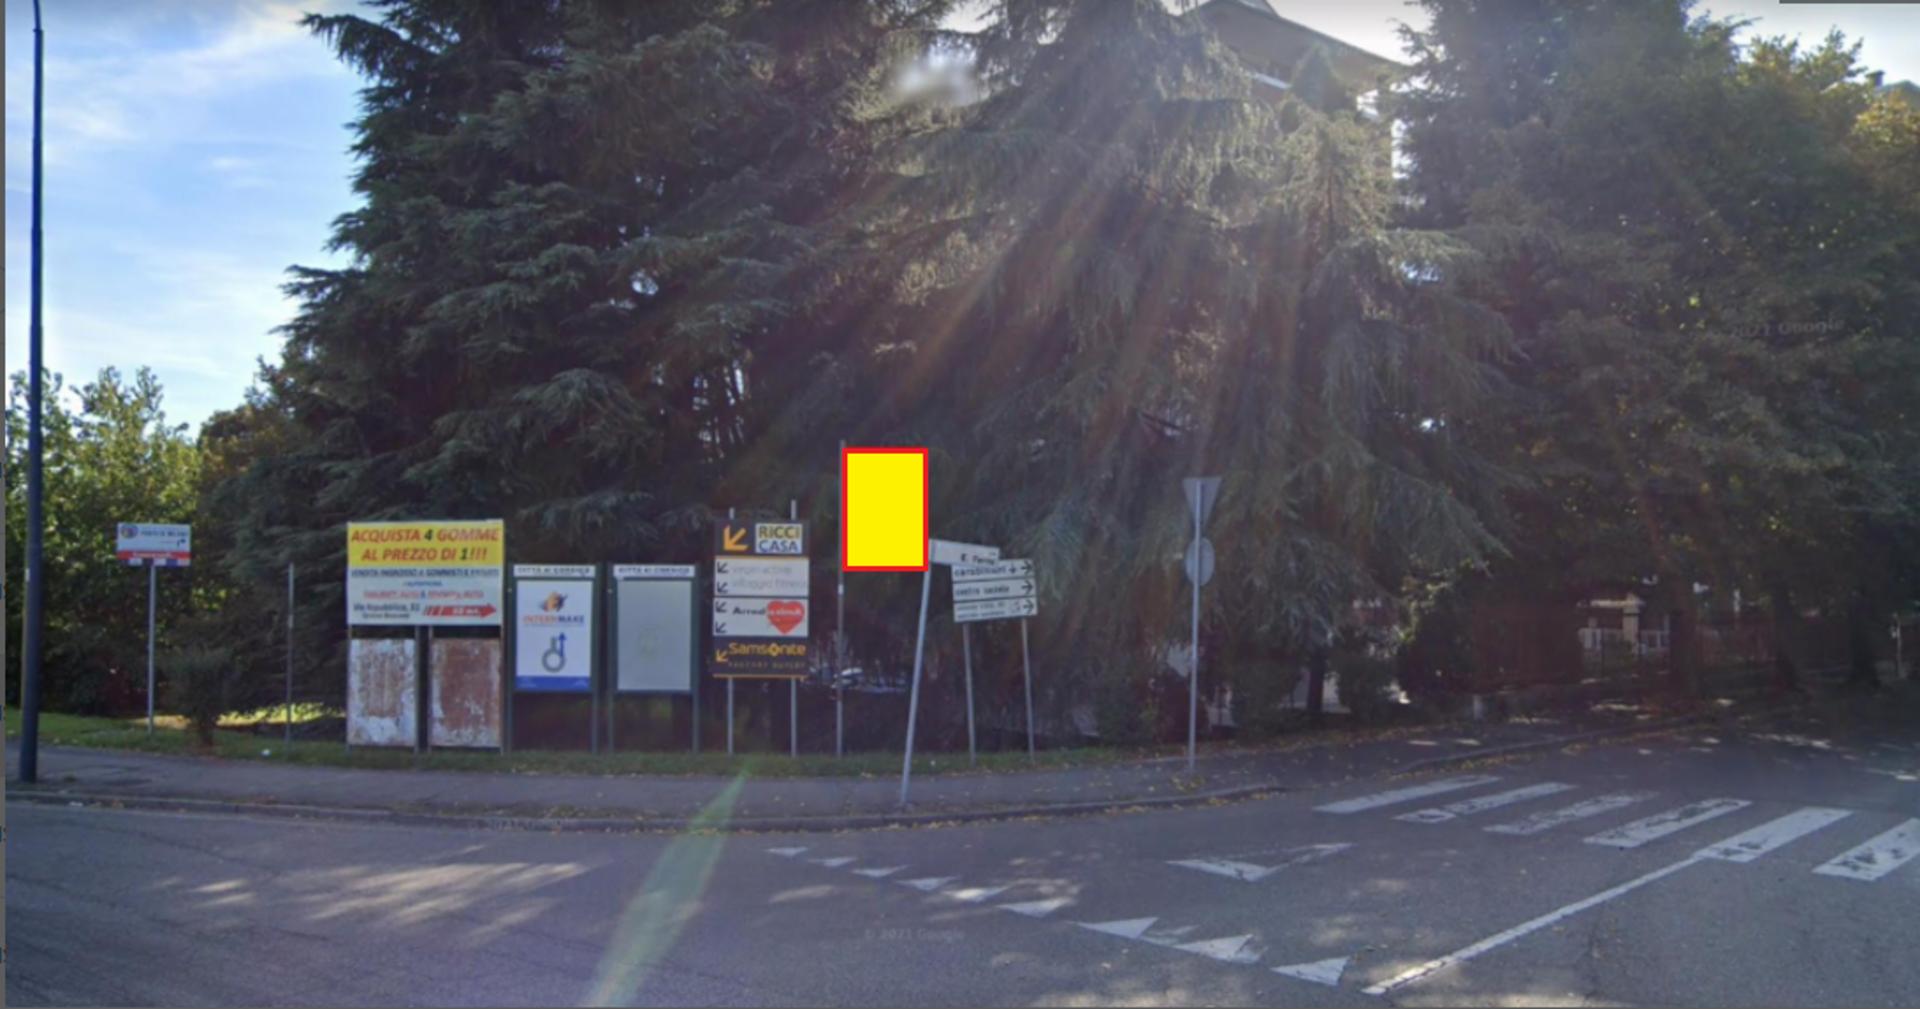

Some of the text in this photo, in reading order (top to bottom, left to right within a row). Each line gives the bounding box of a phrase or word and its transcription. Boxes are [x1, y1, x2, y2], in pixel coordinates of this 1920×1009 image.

[351, 527, 500, 541] ACQUISTA 4 GOMME
[758, 525, 801, 539] RICCI
[758, 540, 799, 553] CASA
[361, 547, 488, 561] AL PREZZO DI 1!!!
[728, 642, 806, 657] Samsonite
